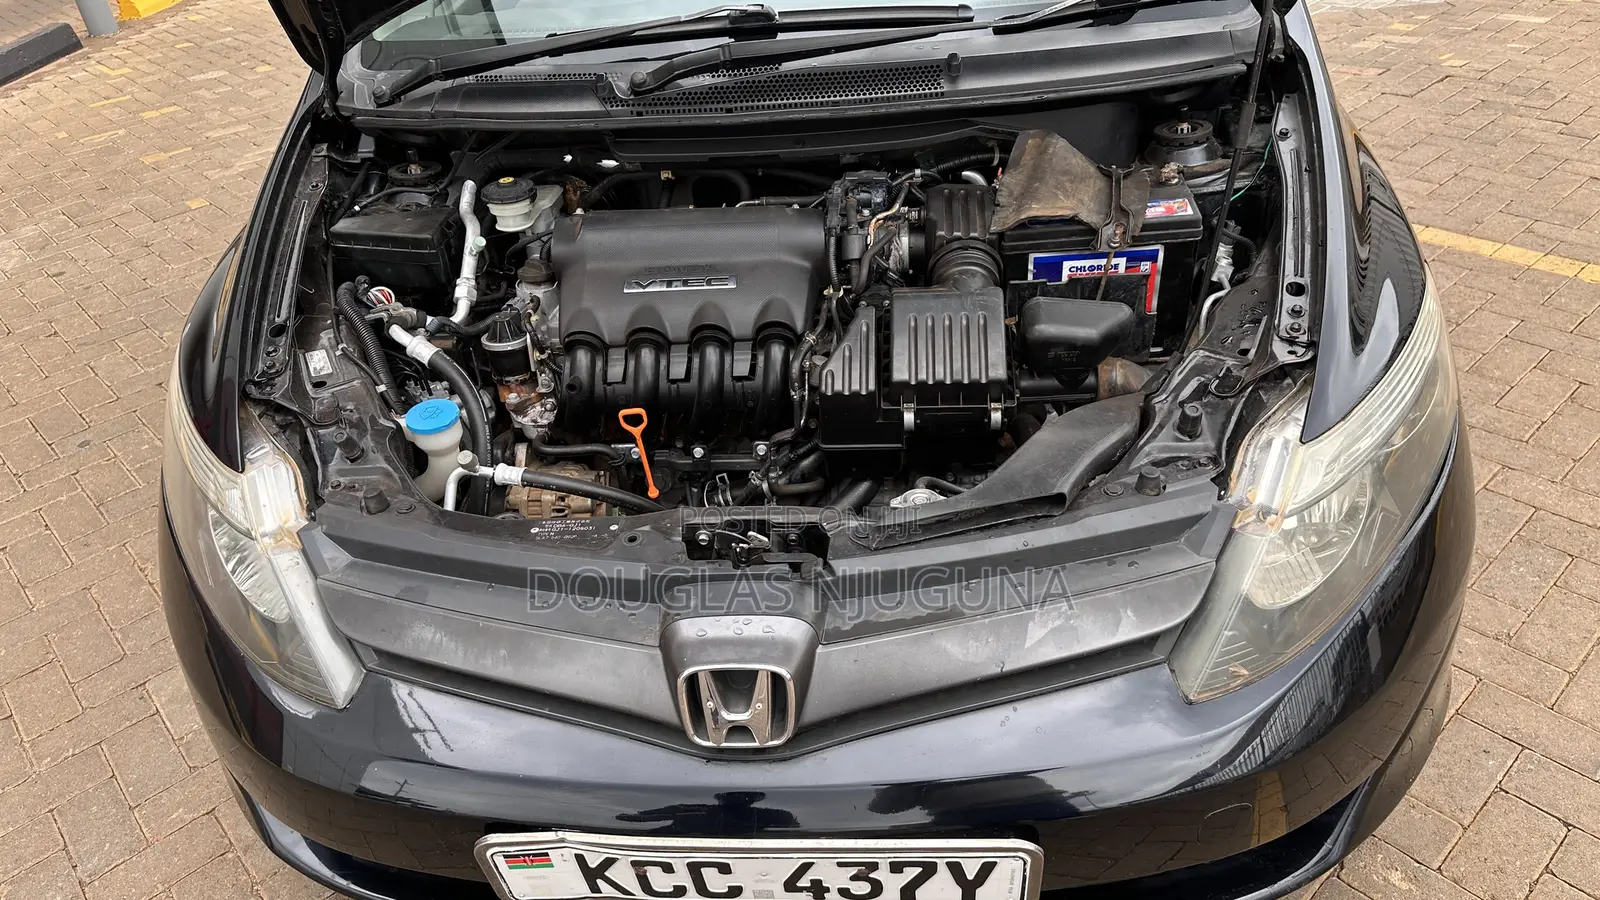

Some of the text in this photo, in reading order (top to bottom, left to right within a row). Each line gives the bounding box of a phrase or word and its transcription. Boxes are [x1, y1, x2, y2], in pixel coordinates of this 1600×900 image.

[629, 275, 733, 291] VTEC
[573, 852, 744, 898] KCC
[782, 860, 999, 900] 437Y
